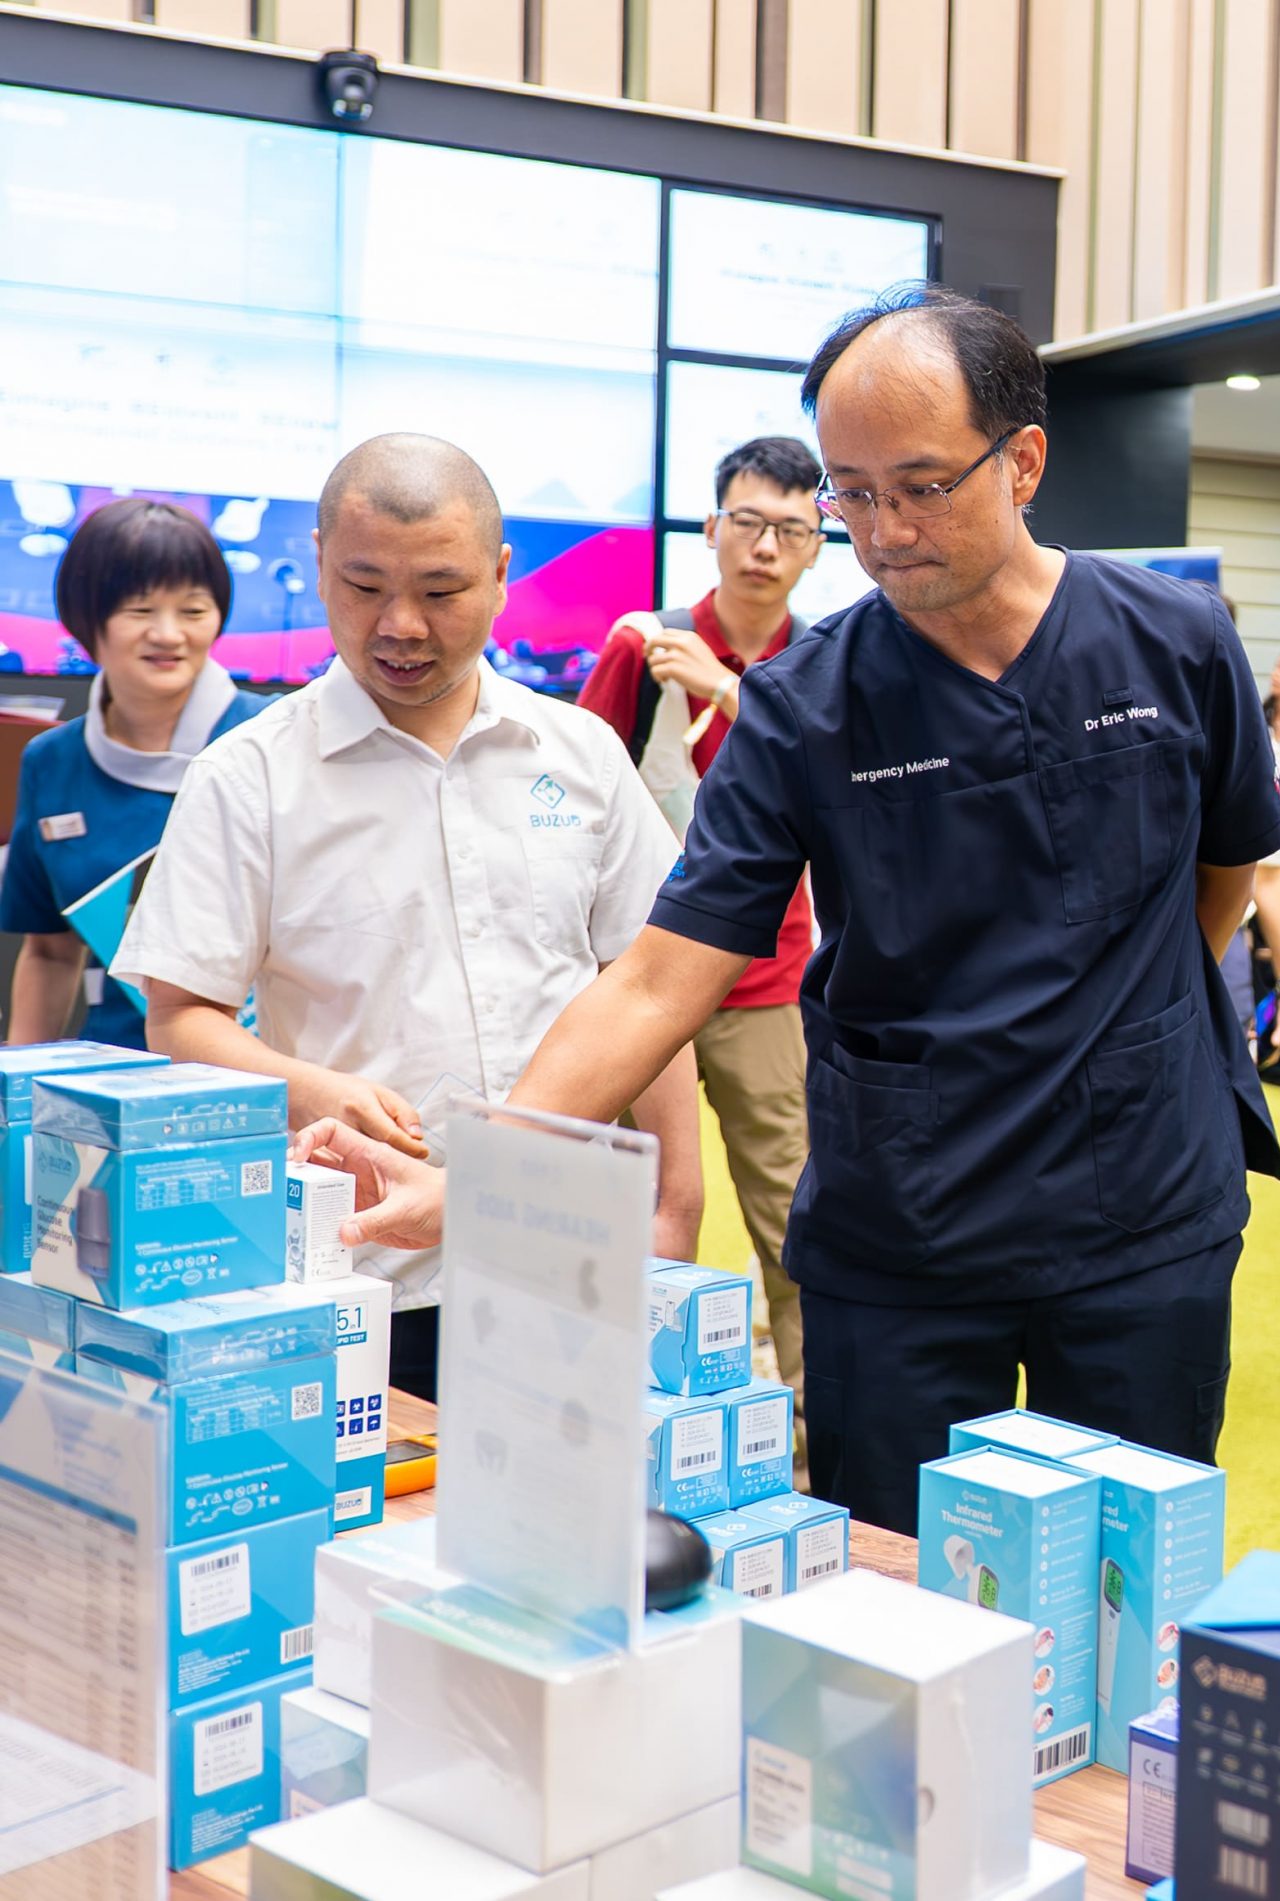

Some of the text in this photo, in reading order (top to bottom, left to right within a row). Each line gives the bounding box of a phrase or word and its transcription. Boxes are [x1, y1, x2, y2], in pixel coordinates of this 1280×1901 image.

[1084, 706, 1158, 731] Dr Eric Wong
[905, 757, 950, 774] Medcine
[288, 1184, 300, 1198] 20
[941, 1509, 1004, 1538] Thermometer
[955, 1502, 993, 1524] Infrared
